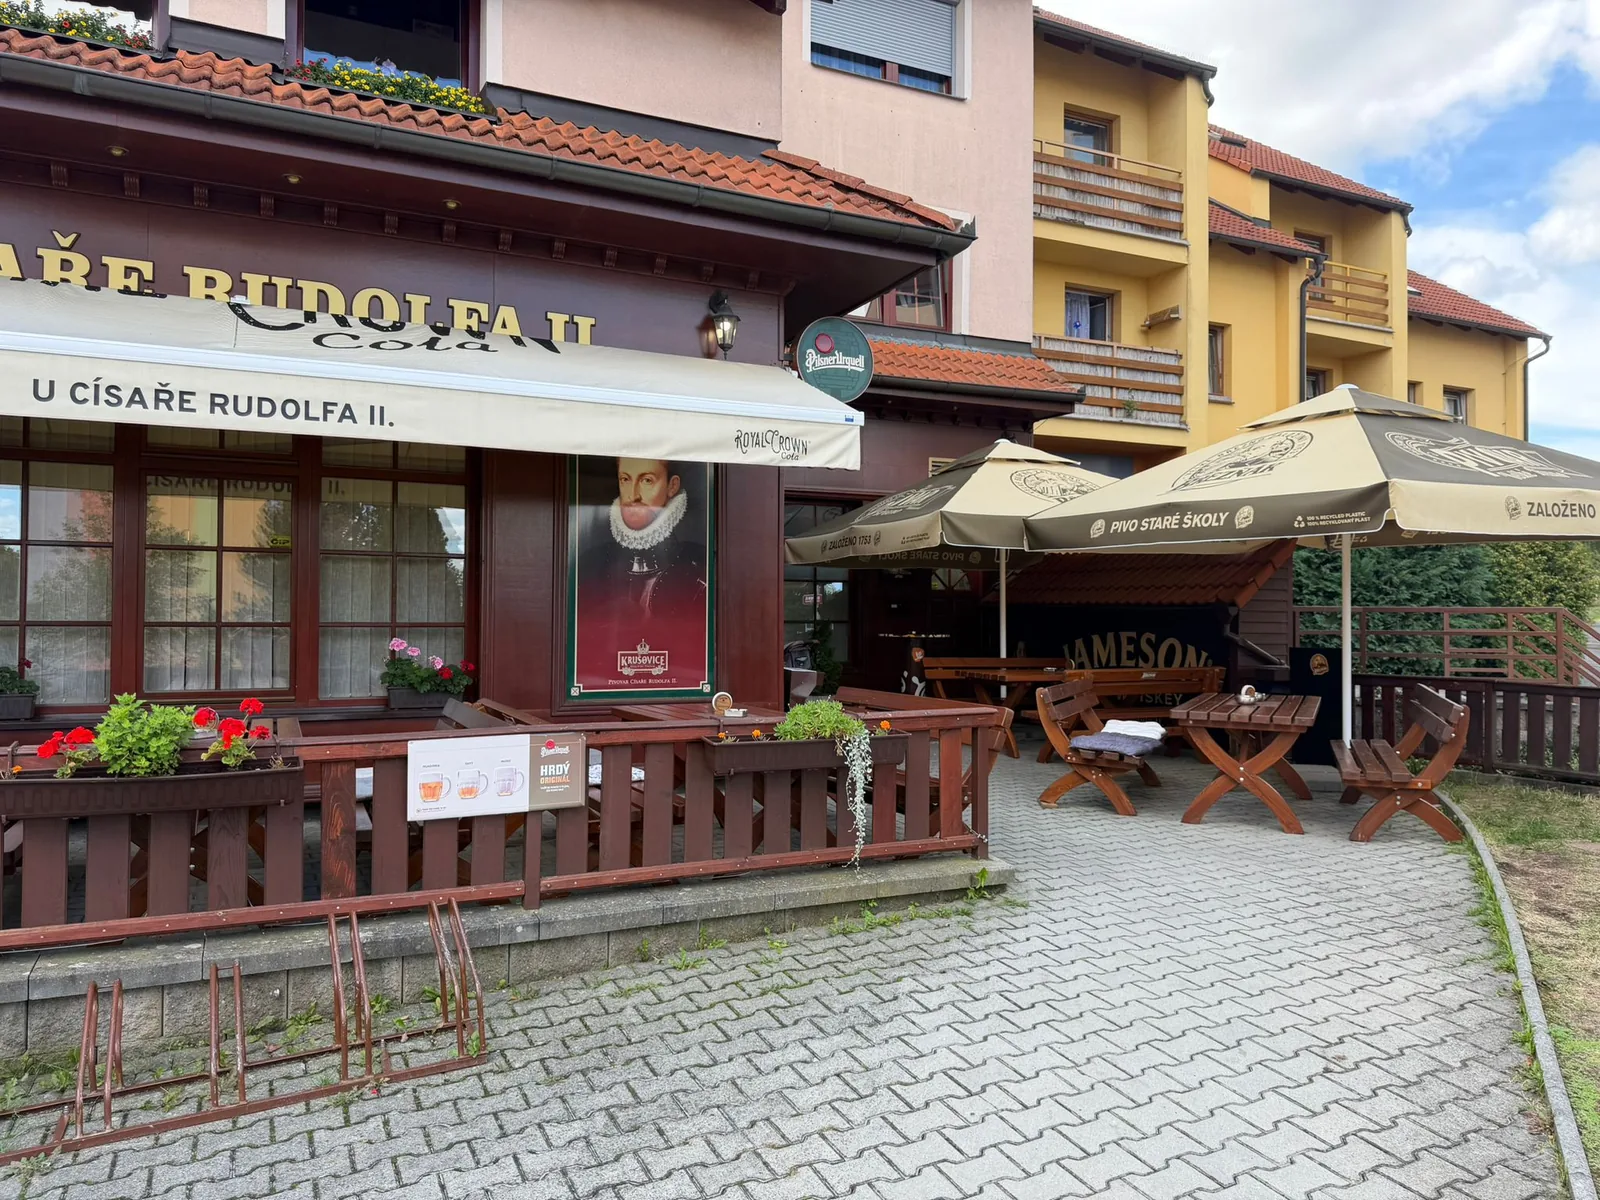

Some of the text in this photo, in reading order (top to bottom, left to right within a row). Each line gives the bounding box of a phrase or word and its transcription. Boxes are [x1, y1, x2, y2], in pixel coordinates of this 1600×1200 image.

[313, 332, 499, 353] Cola
[805, 348, 866, 373] Pilsner Urquell
[32, 377, 395, 427] U CÍSAŘE RUDOLFA II.
[734, 429, 808, 455] ROYAL CROWN
[781, 451, 800, 461] Cola
[1527, 499, 1596, 518] ZALOŽENO
[1110, 511, 1229, 533] PIVO STARÉ ŠKOLY
[828, 534, 872, 551] ZALOŽENO 1753
[621, 653, 665, 667] KRUŠOVICE
[540, 761, 570, 776] HRDÝ
[540, 774, 570, 785] ORIGINÁL
